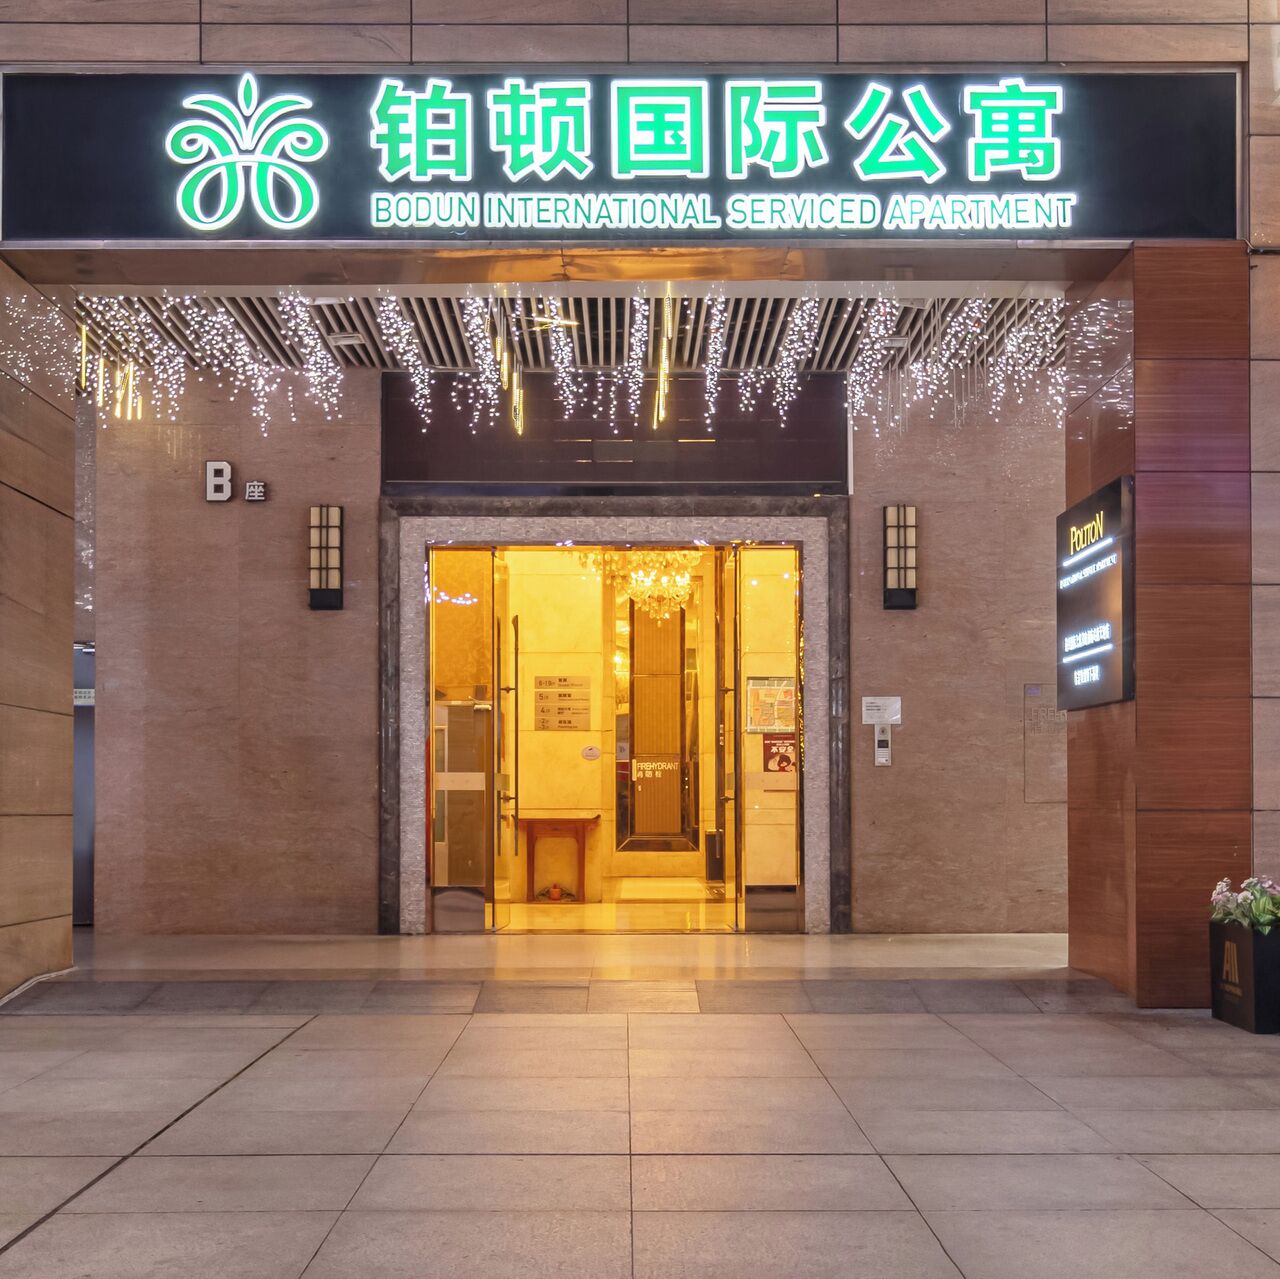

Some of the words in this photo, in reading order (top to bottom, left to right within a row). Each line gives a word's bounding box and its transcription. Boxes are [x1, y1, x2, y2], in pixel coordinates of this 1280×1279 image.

[371, 78, 1064, 183] 铂顿国际公寓
[373, 194, 477, 227] BODUN
[485, 194, 721, 228] INTERNATIONAL
[726, 194, 879, 228] SERVICED
[884, 193, 1077, 229] APARTMENT
